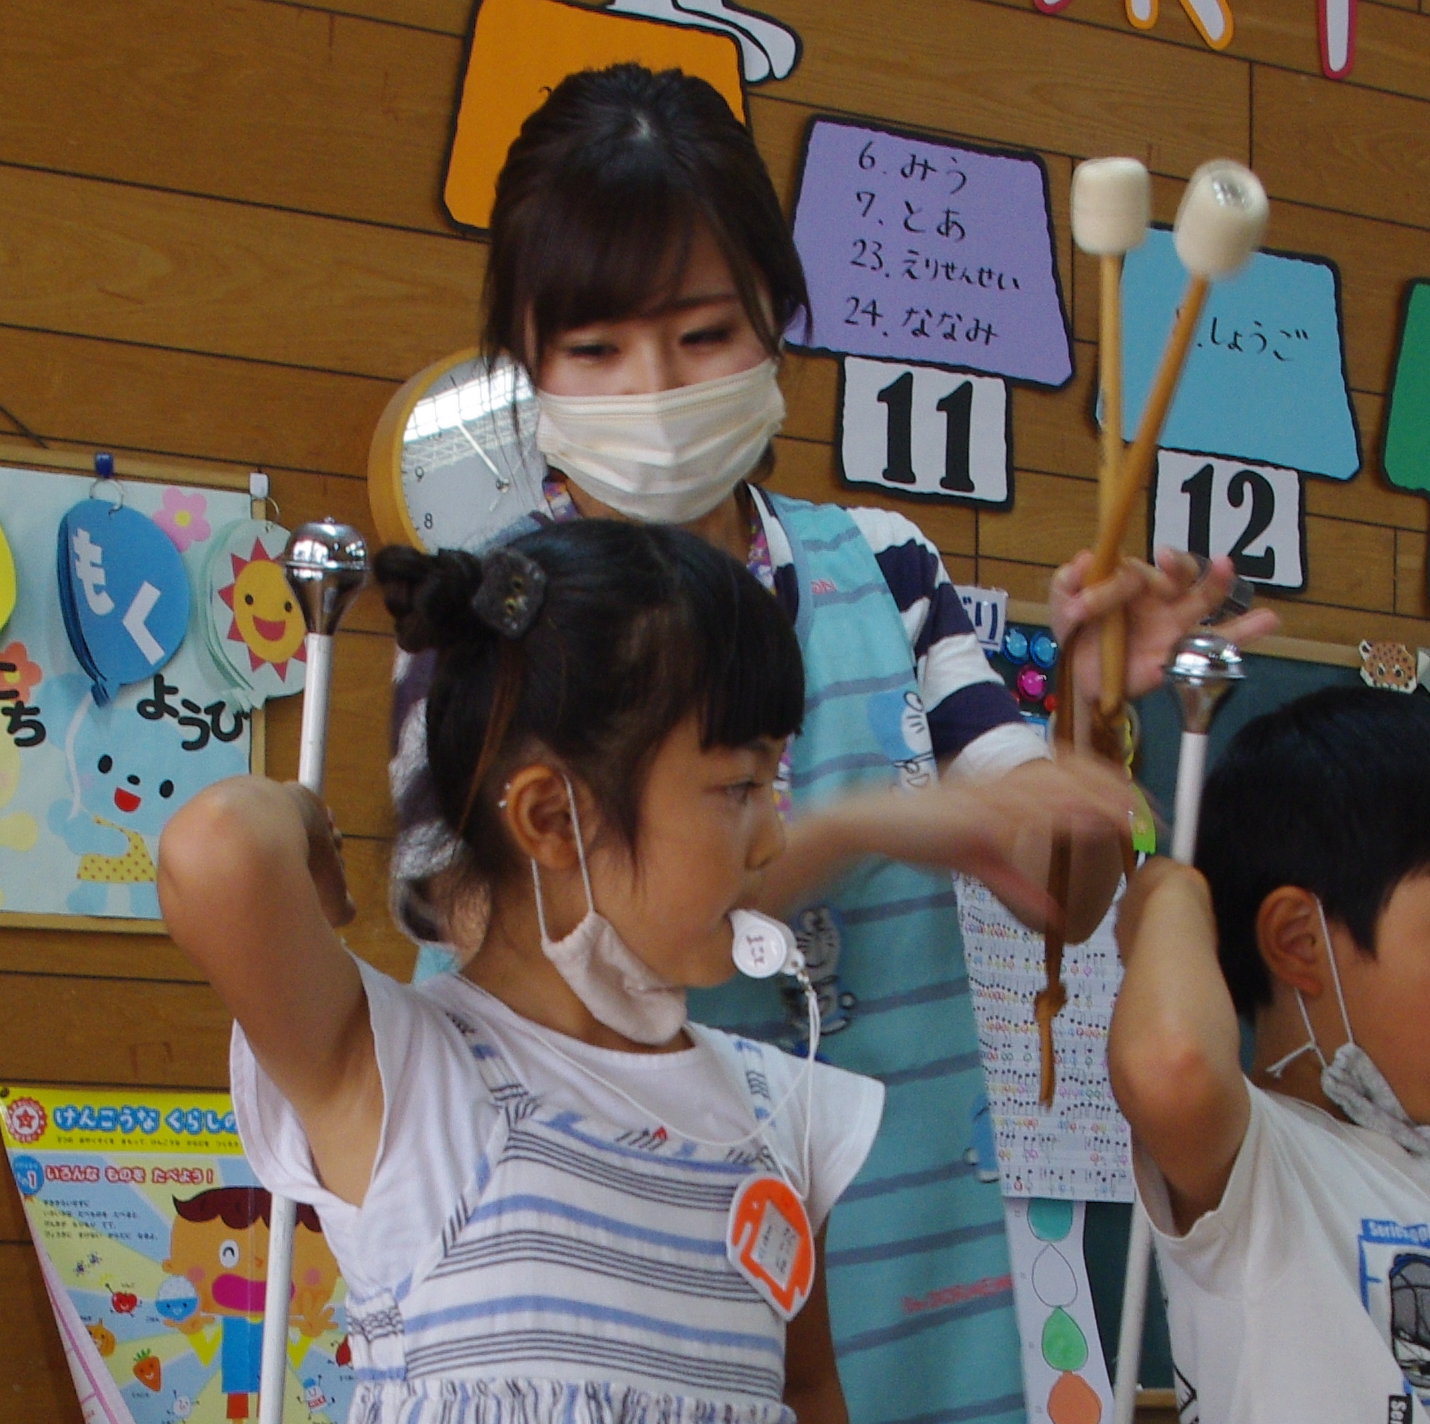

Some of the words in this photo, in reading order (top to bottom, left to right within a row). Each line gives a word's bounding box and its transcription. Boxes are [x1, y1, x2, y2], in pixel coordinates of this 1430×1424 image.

[875, 369, 979, 494] 11
[424, 513, 433, 530] 8
[1180, 464, 1276, 580] 12
[71, 527, 165, 666] もく
[136, 673, 250, 752] ようび
[53, 1105, 160, 1132] けんこうな
